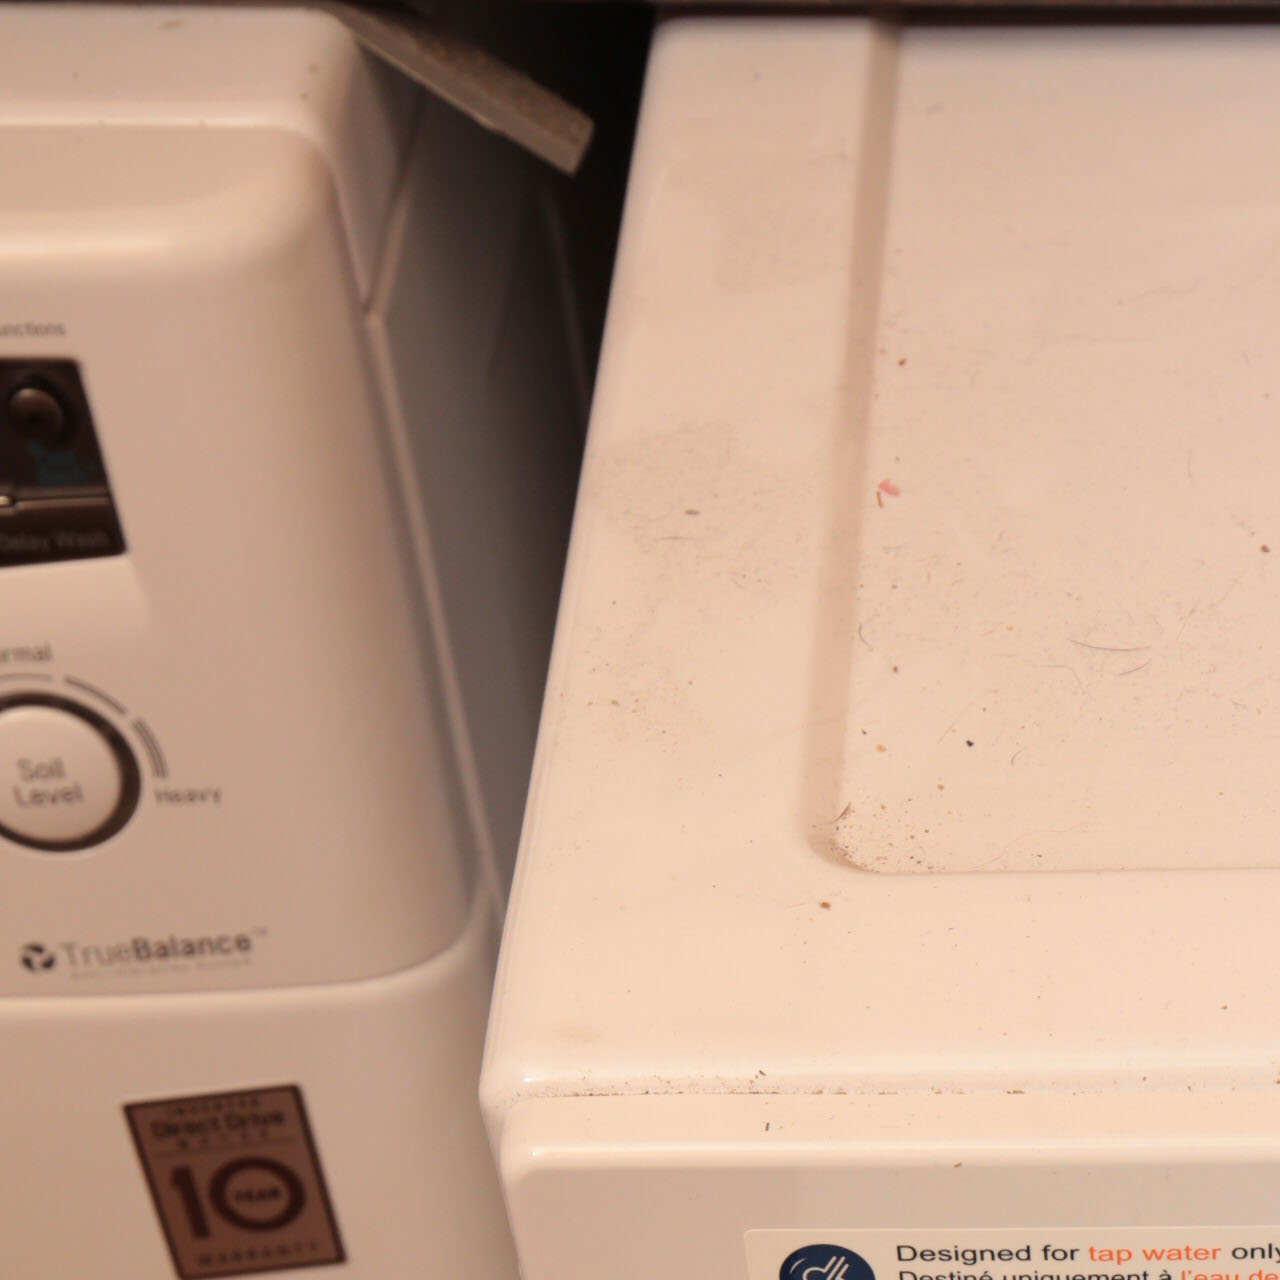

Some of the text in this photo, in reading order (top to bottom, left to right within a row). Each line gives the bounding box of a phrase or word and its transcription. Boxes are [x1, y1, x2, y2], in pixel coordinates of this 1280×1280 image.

[17, 758, 67, 783] Soil
[13, 784, 84, 808] Level
[154, 788, 221, 805] Heavy
[896, 1245, 1031, 1265] Designed
[1042, 1245, 1079, 1261] for
[1089, 1246, 1132, 1264] tap
[1142, 1245, 1221, 1261] water
